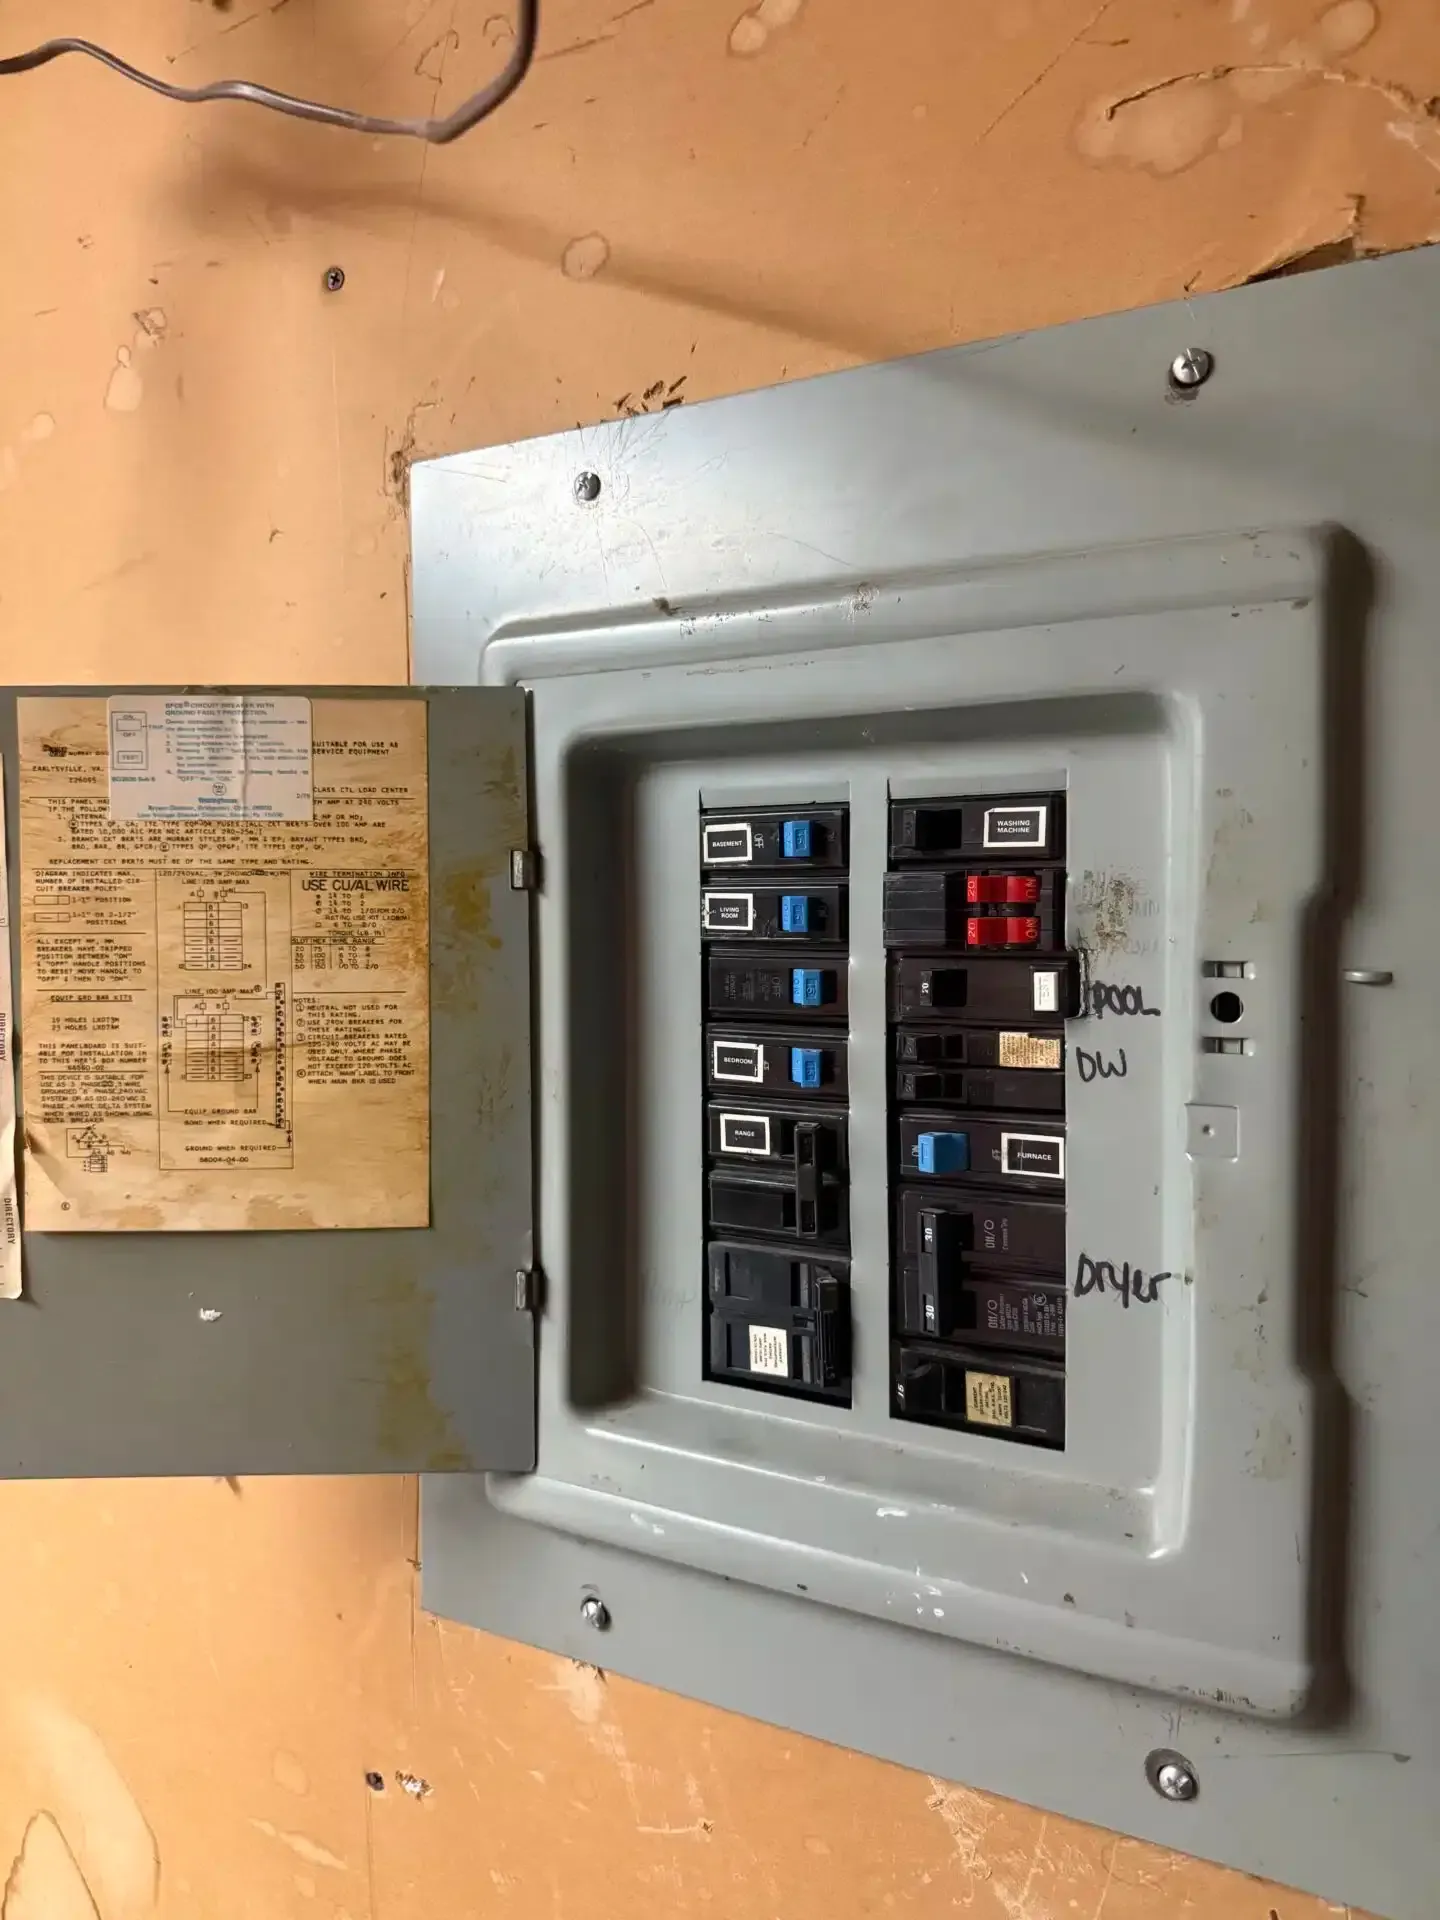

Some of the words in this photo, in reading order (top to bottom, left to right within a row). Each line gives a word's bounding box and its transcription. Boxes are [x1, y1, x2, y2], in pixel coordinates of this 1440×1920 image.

[302, 880, 328, 891] USE
[332, 880, 374, 891] CU/AL
[376, 880, 410, 891] WIRE
[968, 880, 975, 896] 20
[968, 922, 976, 938] 20
[1025, 919, 1038, 939] ON
[922, 982, 929, 994] 20
[1092, 980, 1160, 1020] POOL
[1076, 1047, 1127, 1082] DW
[1017, 1152, 1052, 1161] FURNACE
[4, 1198, 16, 1244] DIRECTORY
[925, 1227, 933, 1242] 30
[1074, 1253, 1172, 1308] Dryer
[926, 1305, 935, 1319] 30
[898, 1384, 905, 1398] 15
